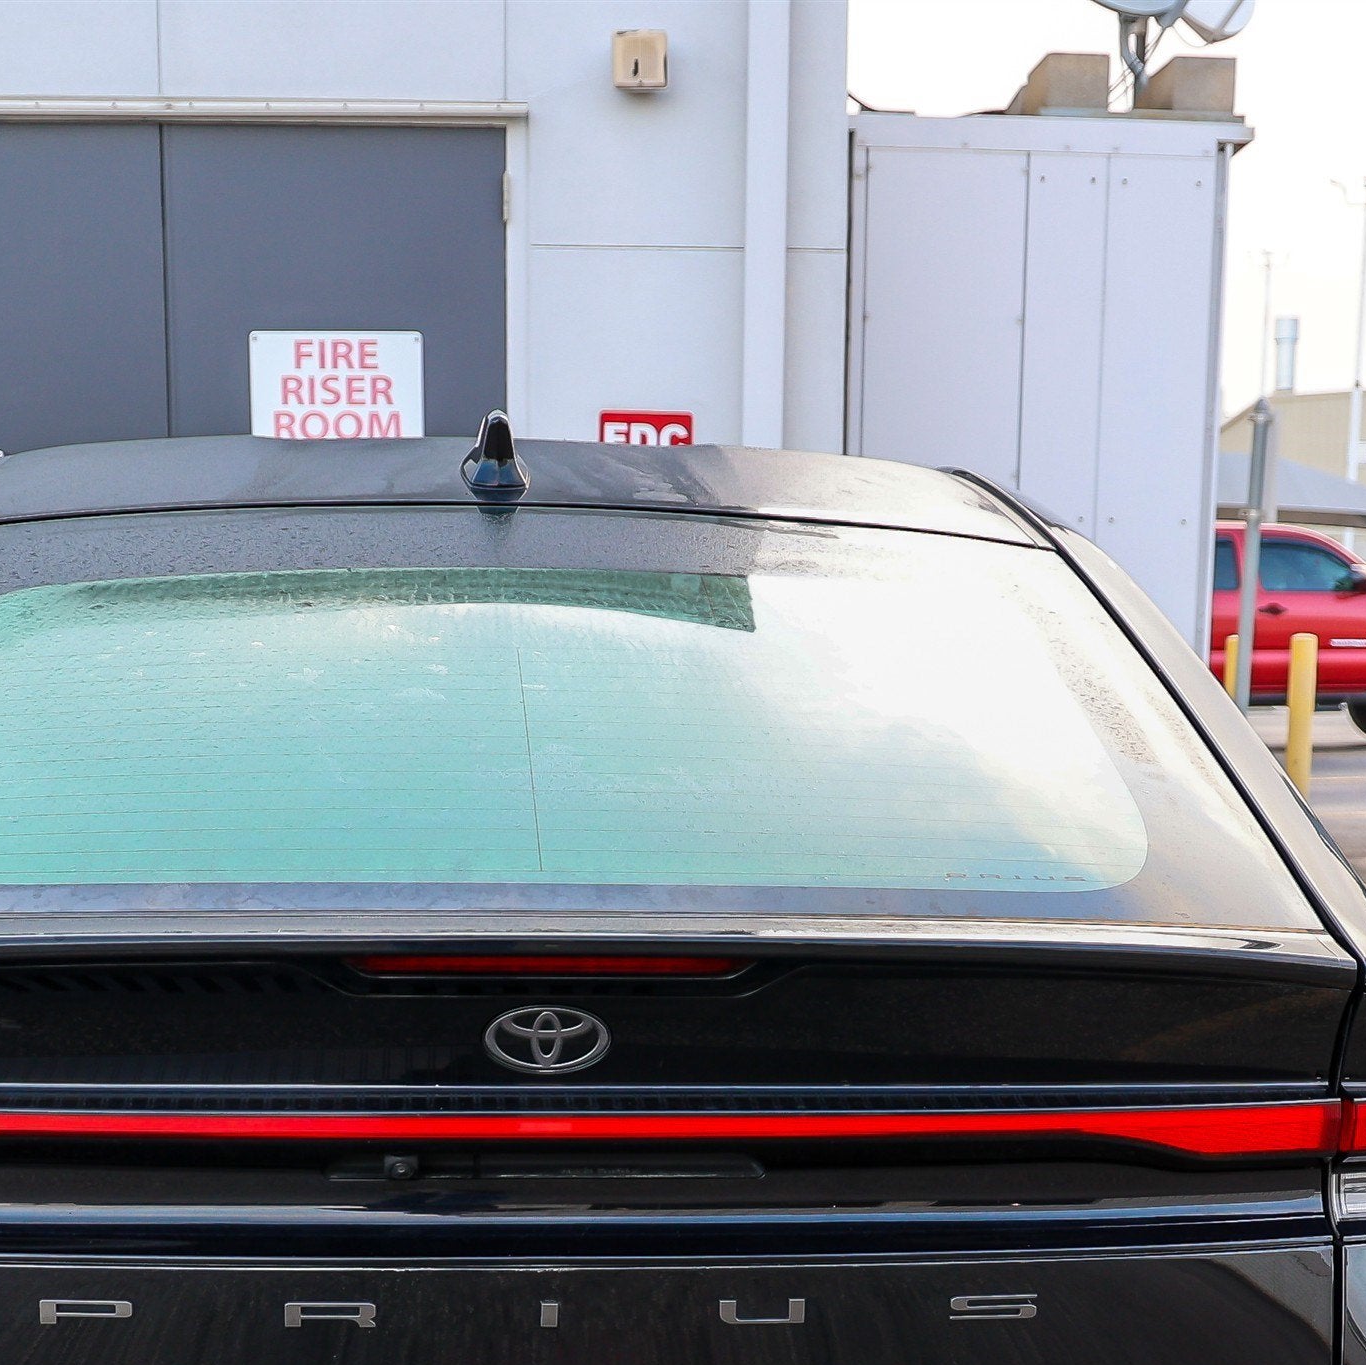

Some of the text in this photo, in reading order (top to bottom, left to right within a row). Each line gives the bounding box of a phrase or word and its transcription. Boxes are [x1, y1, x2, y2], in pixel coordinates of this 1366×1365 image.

[294, 338, 380, 369] FIRE
[280, 374, 395, 405] RISER
[273, 409, 404, 439] ROOM
[39, 1294, 1038, 1328] PRIUS
